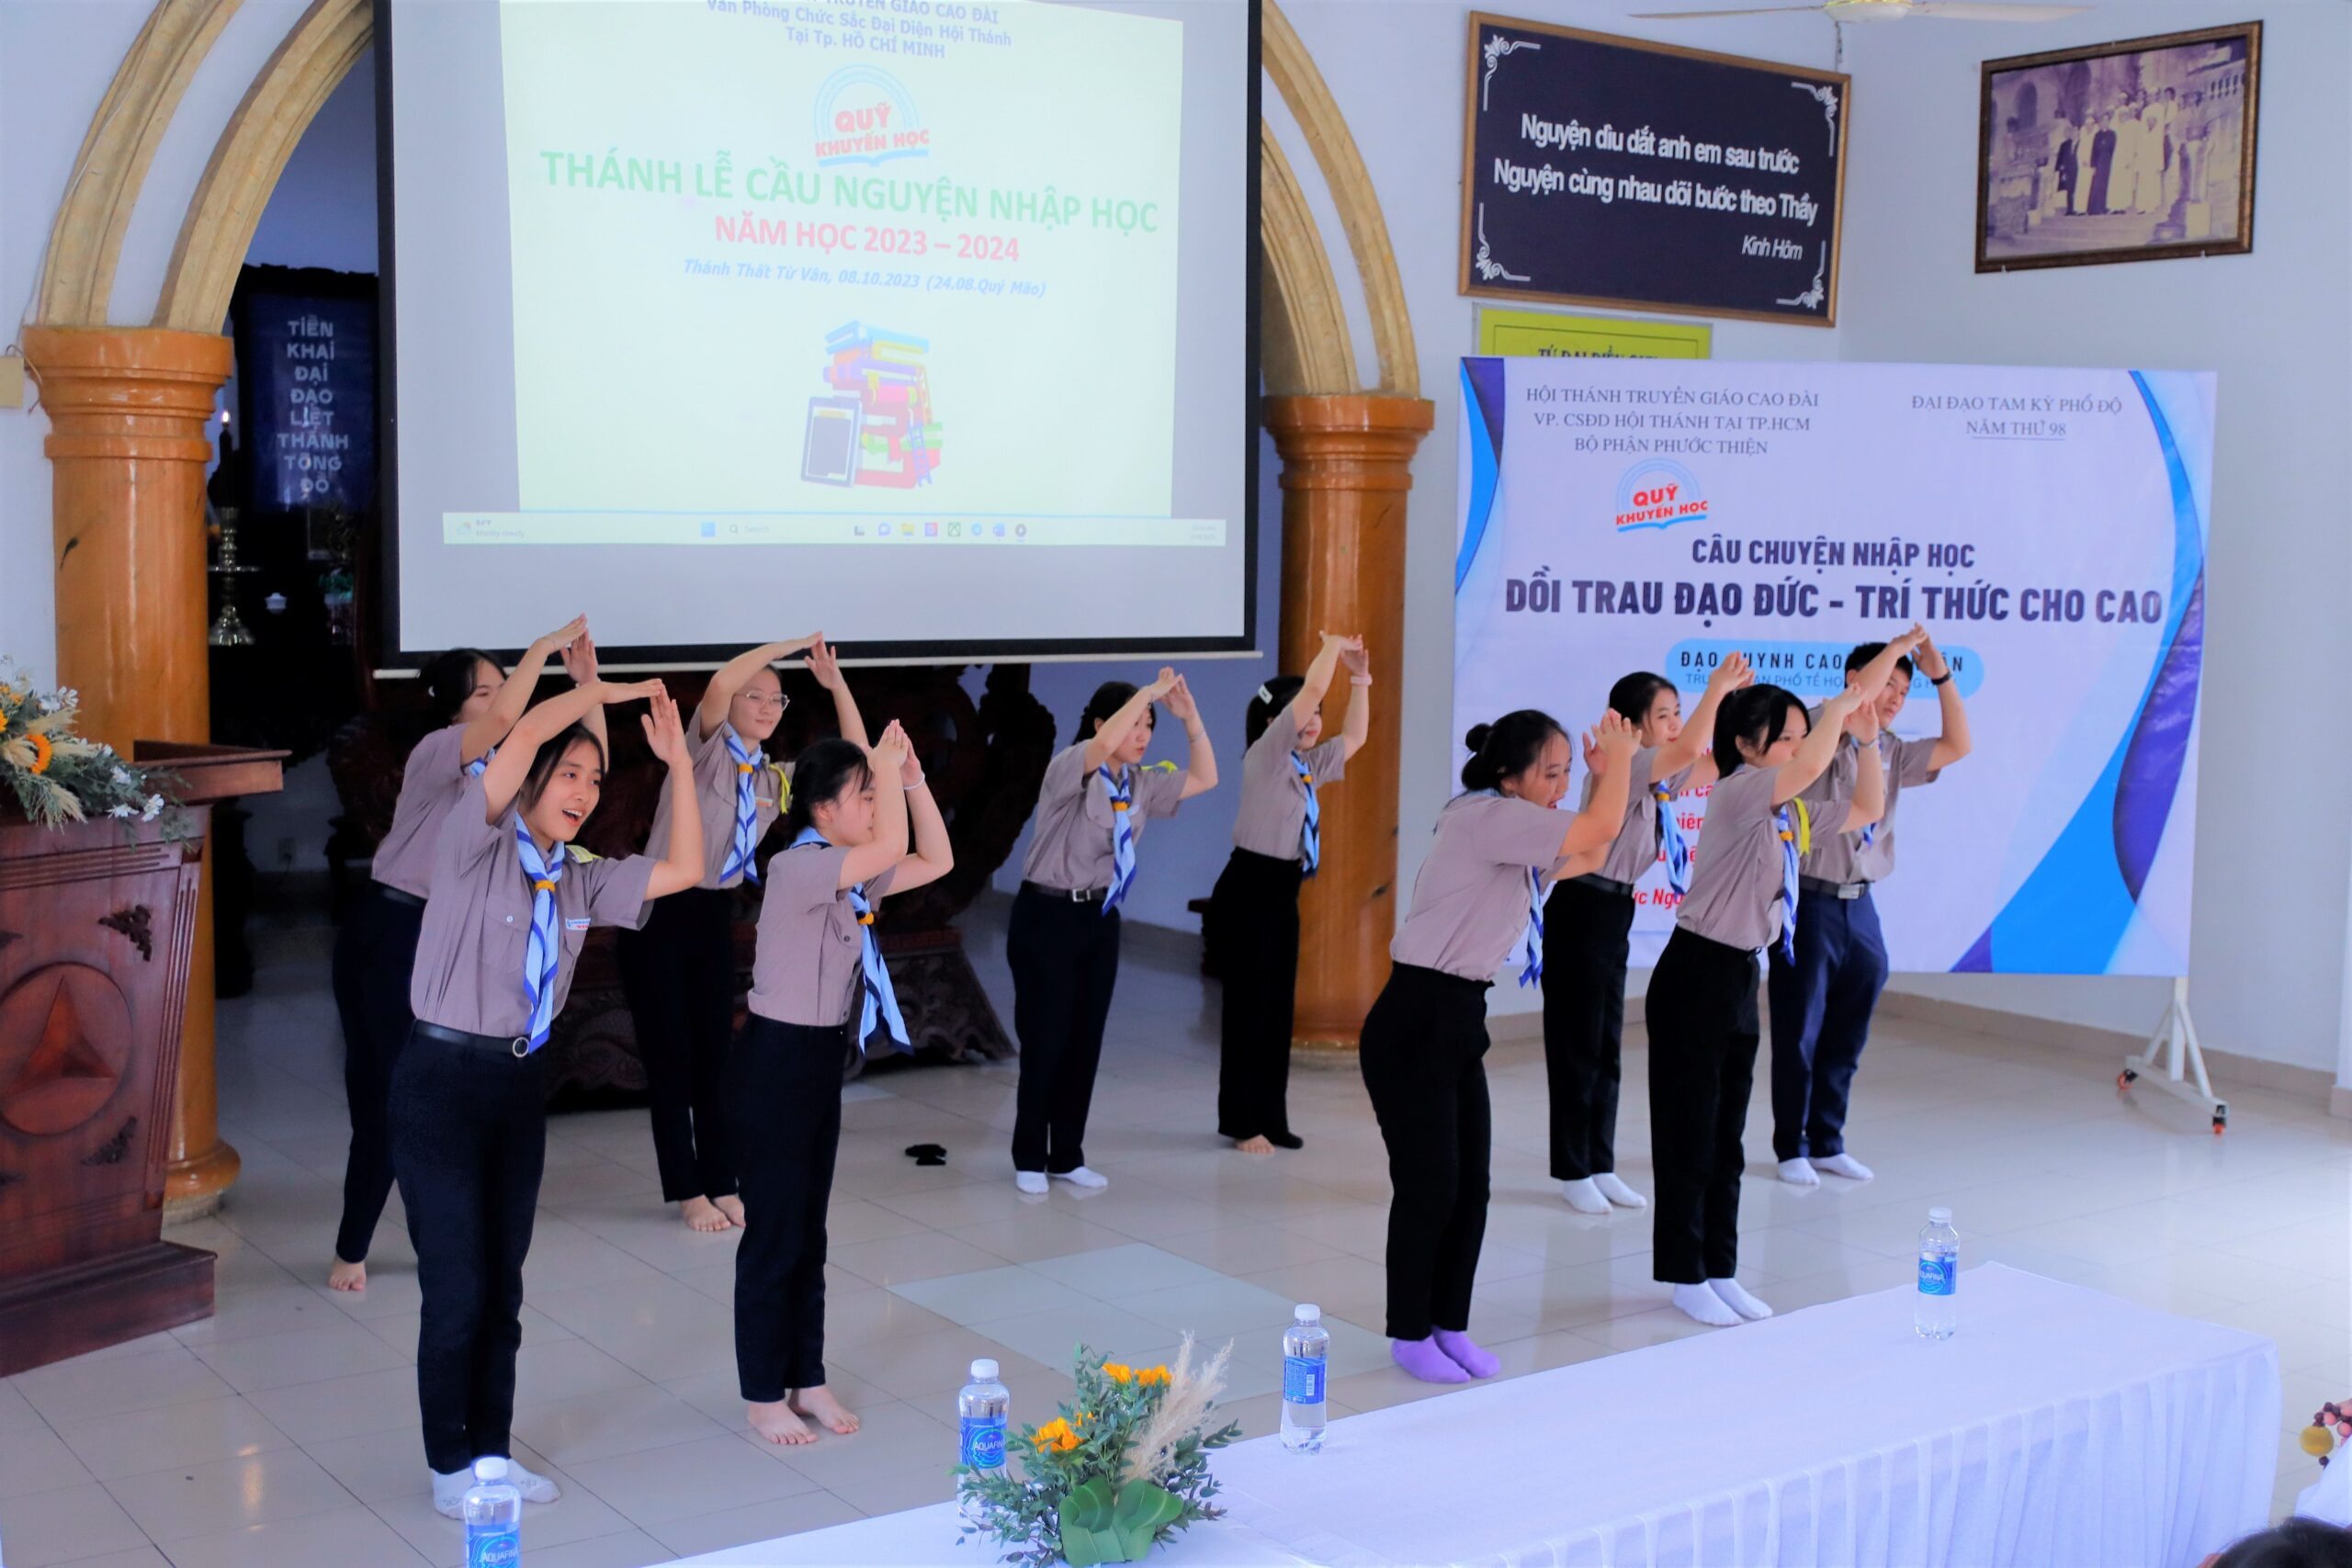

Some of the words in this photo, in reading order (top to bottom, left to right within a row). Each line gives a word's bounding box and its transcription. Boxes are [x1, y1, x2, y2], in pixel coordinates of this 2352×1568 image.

[742, 1, 790, 22] Phòng
[795, 5, 835, 26] Chức
[839, 10, 867, 28] Sắc
[870, 16, 896, 34] Đại
[900, 20, 933, 39] Diện
[939, 24, 964, 42] Hội
[968, 26, 1012, 47] Thánh
[935, 4, 967, 20] CAO
[971, 4, 1000, 25] ĐÀI
[786, 26, 809, 44] Tại
[814, 29, 838, 48] Tp.
[869, 35, 899, 53] CHÍ
[903, 39, 945, 59] MINH
[834, 101, 892, 134] QUỸ
[892, 129, 931, 150] HỌC
[1521, 112, 1592, 152] Nguyện
[1626, 125, 1657, 155] dắt
[1657, 134, 1693, 162] anh
[1694, 141, 1723, 164] em
[1724, 146, 1756, 168] sau
[1758, 147, 1801, 175] trước
[539, 146, 683, 195] THÁNH
[695, 148, 734, 199] LỄ
[744, 155, 821, 206] CẦU
[833, 175, 979, 223] NGUYỆN
[989, 185, 1082, 231] NHẬP
[1091, 196, 1159, 238] HỌC
[1494, 156, 1566, 196] Nguyện
[1568, 167, 1615, 203] cùng
[1617, 177, 1663, 204] nhau
[1665, 181, 1692, 208] dõi
[1694, 186, 1738, 212] bước
[1739, 188, 1777, 218] theo
[1780, 191, 1819, 228] Thầy
[715, 210, 787, 246] NĂM
[796, 220, 858, 255] HỌC
[864, 226, 928, 256] 2023
[957, 232, 1021, 263] 2024
[1773, 235, 1804, 262] Hôm
[683, 258, 732, 278] Thánh
[736, 262, 771, 281] Thất
[775, 265, 797, 282] Từ
[801, 266, 833, 287] Vân,
[837, 269, 921, 288] 08.10.2023
[925, 274, 1006, 297] (24.08.Quý
[1010, 280, 1047, 299] Mão)
[286, 340, 335, 361] KHAI
[294, 362, 329, 386] ĐẠI
[1526, 385, 1557, 403] HỘI
[1561, 385, 1622, 404] THÁNH
[1700, 389, 1745, 406] GIÁO
[1747, 391, 1784, 407] CAO
[1788, 390, 1819, 408] ĐÀI
[1911, 395, 1942, 412] ĐẠI
[1946, 397, 1984, 413] ĐẠO
[1988, 397, 2026, 412] TAM
[2098, 397, 2123, 416] ĐỘ
[1533, 412, 1559, 427] VP.
[1564, 413, 1610, 427] CSĐD
[1613, 412, 1645, 430] HỘI
[1649, 412, 1710, 430] THÁNH
[1714, 414, 1743, 433] TẠI
[1747, 416, 1811, 432] TP.HCM
[1965, 421, 2007, 435] NĂM
[2049, 423, 2067, 437] 98
[1574, 435, 1600, 454] BỘ
[1602, 436, 1650, 456] PHẬN
[1654, 437, 1713, 454] PHƯỚC
[1716, 438, 1769, 457] THIỆN
[1633, 483, 1680, 507] QUỸ
[1616, 504, 1674, 526] KHUYẾN
[1679, 500, 1709, 516] HỌC
[1692, 534, 1741, 565] CÂU
[1748, 536, 1845, 574] CHUYỆN
[1852, 537, 1920, 576] NHẬP
[1928, 543, 1975, 577] HỌC
[1506, 565, 1561, 614] DỒI
[1572, 581, 1664, 615] TRAU
[1674, 582, 1743, 628] ĐẠO
[1754, 575, 1819, 617] ĐỨC
[1855, 578, 1911, 619] TRÍ
[1921, 579, 2010, 622] THỨC
[2019, 589, 2085, 623] CHO
[2095, 590, 2163, 625] CAO
[1680, 651, 1718, 671] ĐẠO
[1805, 654, 1842, 670] CAO
[974, 1440, 1004, 1451] AQUAFIN
